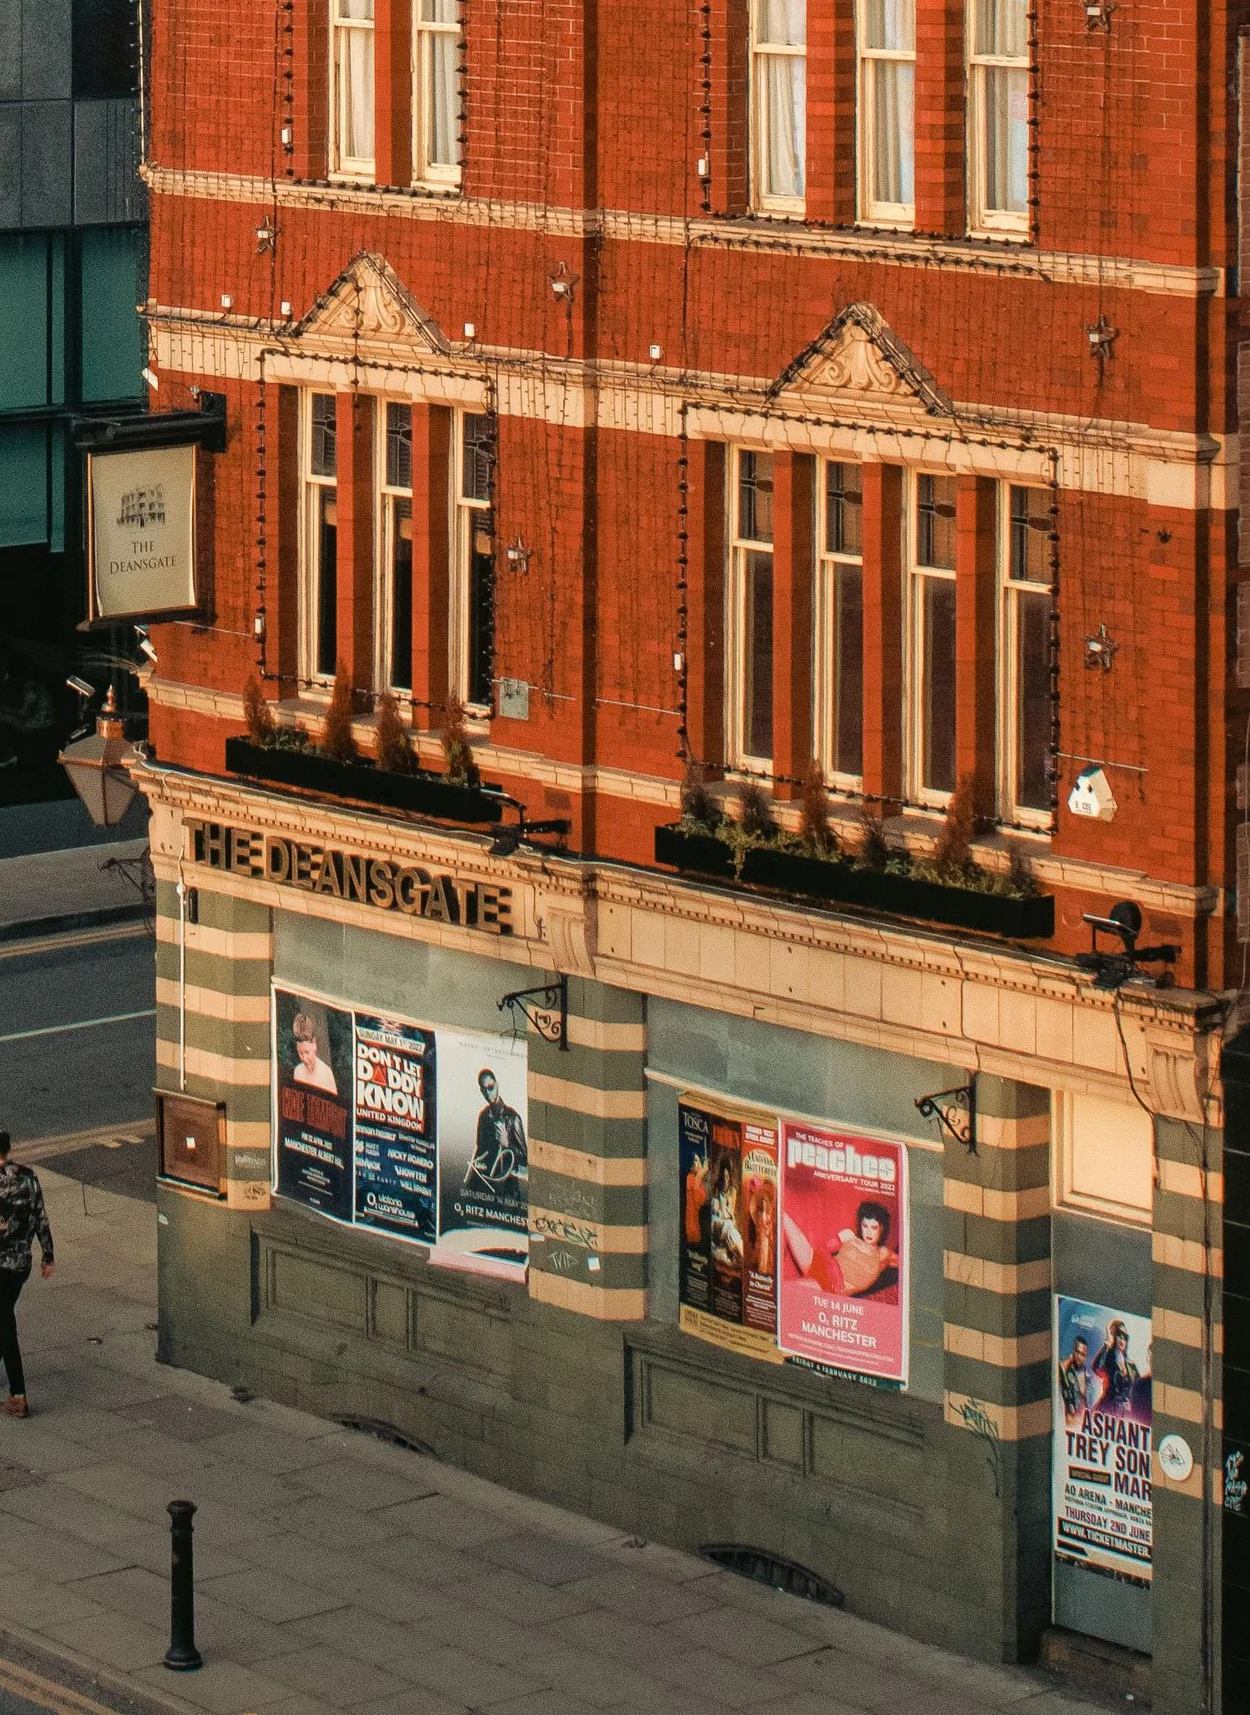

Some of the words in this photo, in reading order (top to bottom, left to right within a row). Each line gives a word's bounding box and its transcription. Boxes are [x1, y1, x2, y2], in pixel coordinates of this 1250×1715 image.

[131, 540, 155, 554] THE
[110, 555, 177, 574] DEANSGATE
[182, 817, 263, 878] THE
[265, 835, 513, 935] DEANSGATE
[359, 1029, 384, 1041] SUNDAY
[384, 1035, 397, 1044] MAY
[403, 1058, 421, 1078] LET
[357, 1079, 424, 1121] KNOW
[356, 1107, 386, 1121] UNITED
[387, 1115, 422, 1131] KINGDOM
[682, 1111, 709, 1135] TOSCA
[795, 1132, 807, 1142] THE
[808, 1135, 833, 1147] TEACHES
[834, 1140, 844, 1148] OF
[787, 1137, 896, 1183] peaches
[860, 1178, 879, 1188] TOUR
[880, 1182, 895, 1191] 2022
[459, 1188, 495, 1202] SATURDAY
[504, 1198, 518, 1207] MAY
[465, 1205, 485, 1217] RITZ
[813, 1295, 828, 1307] TUE
[830, 1300, 840, 1310] 14
[842, 1303, 864, 1316] JUNE
[832, 1314, 858, 1331] RITZ
[802, 1320, 877, 1348] MANCHESTER
[1081, 1407, 1150, 1451] ASHANT
[1065, 1429, 1110, 1466] TREY
[1115, 1445, 1150, 1478] SON
[1064, 1483, 1076, 1496] AO
[1078, 1487, 1107, 1505] ARENA
[1065, 1505, 1108, 1529] THURSDAY
[1110, 1519, 1127, 1534] 2ND
[1129, 1525, 1150, 1542] JUNE
